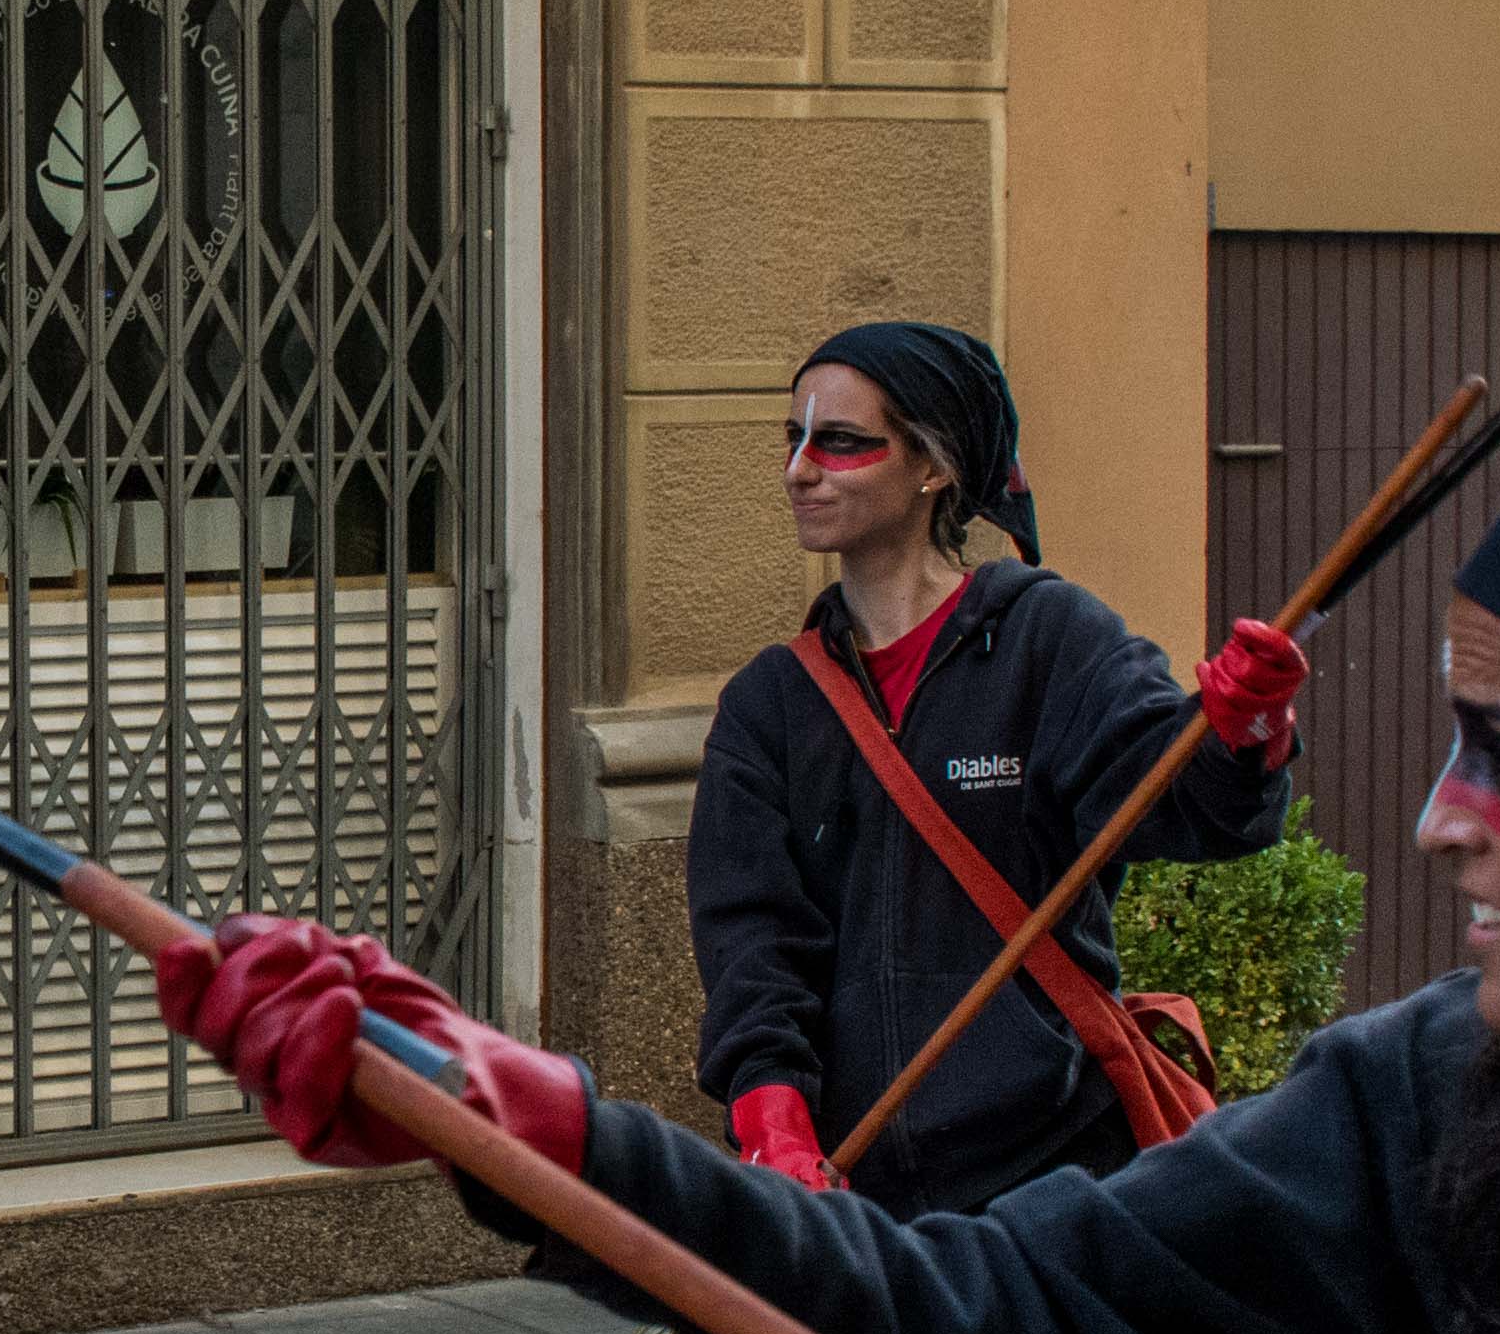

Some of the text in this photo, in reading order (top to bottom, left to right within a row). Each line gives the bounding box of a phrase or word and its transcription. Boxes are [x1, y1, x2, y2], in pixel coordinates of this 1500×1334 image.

[946, 755, 1021, 780] Diables
[960, 781, 972, 791] DE
[974, 779, 995, 789] SANT
